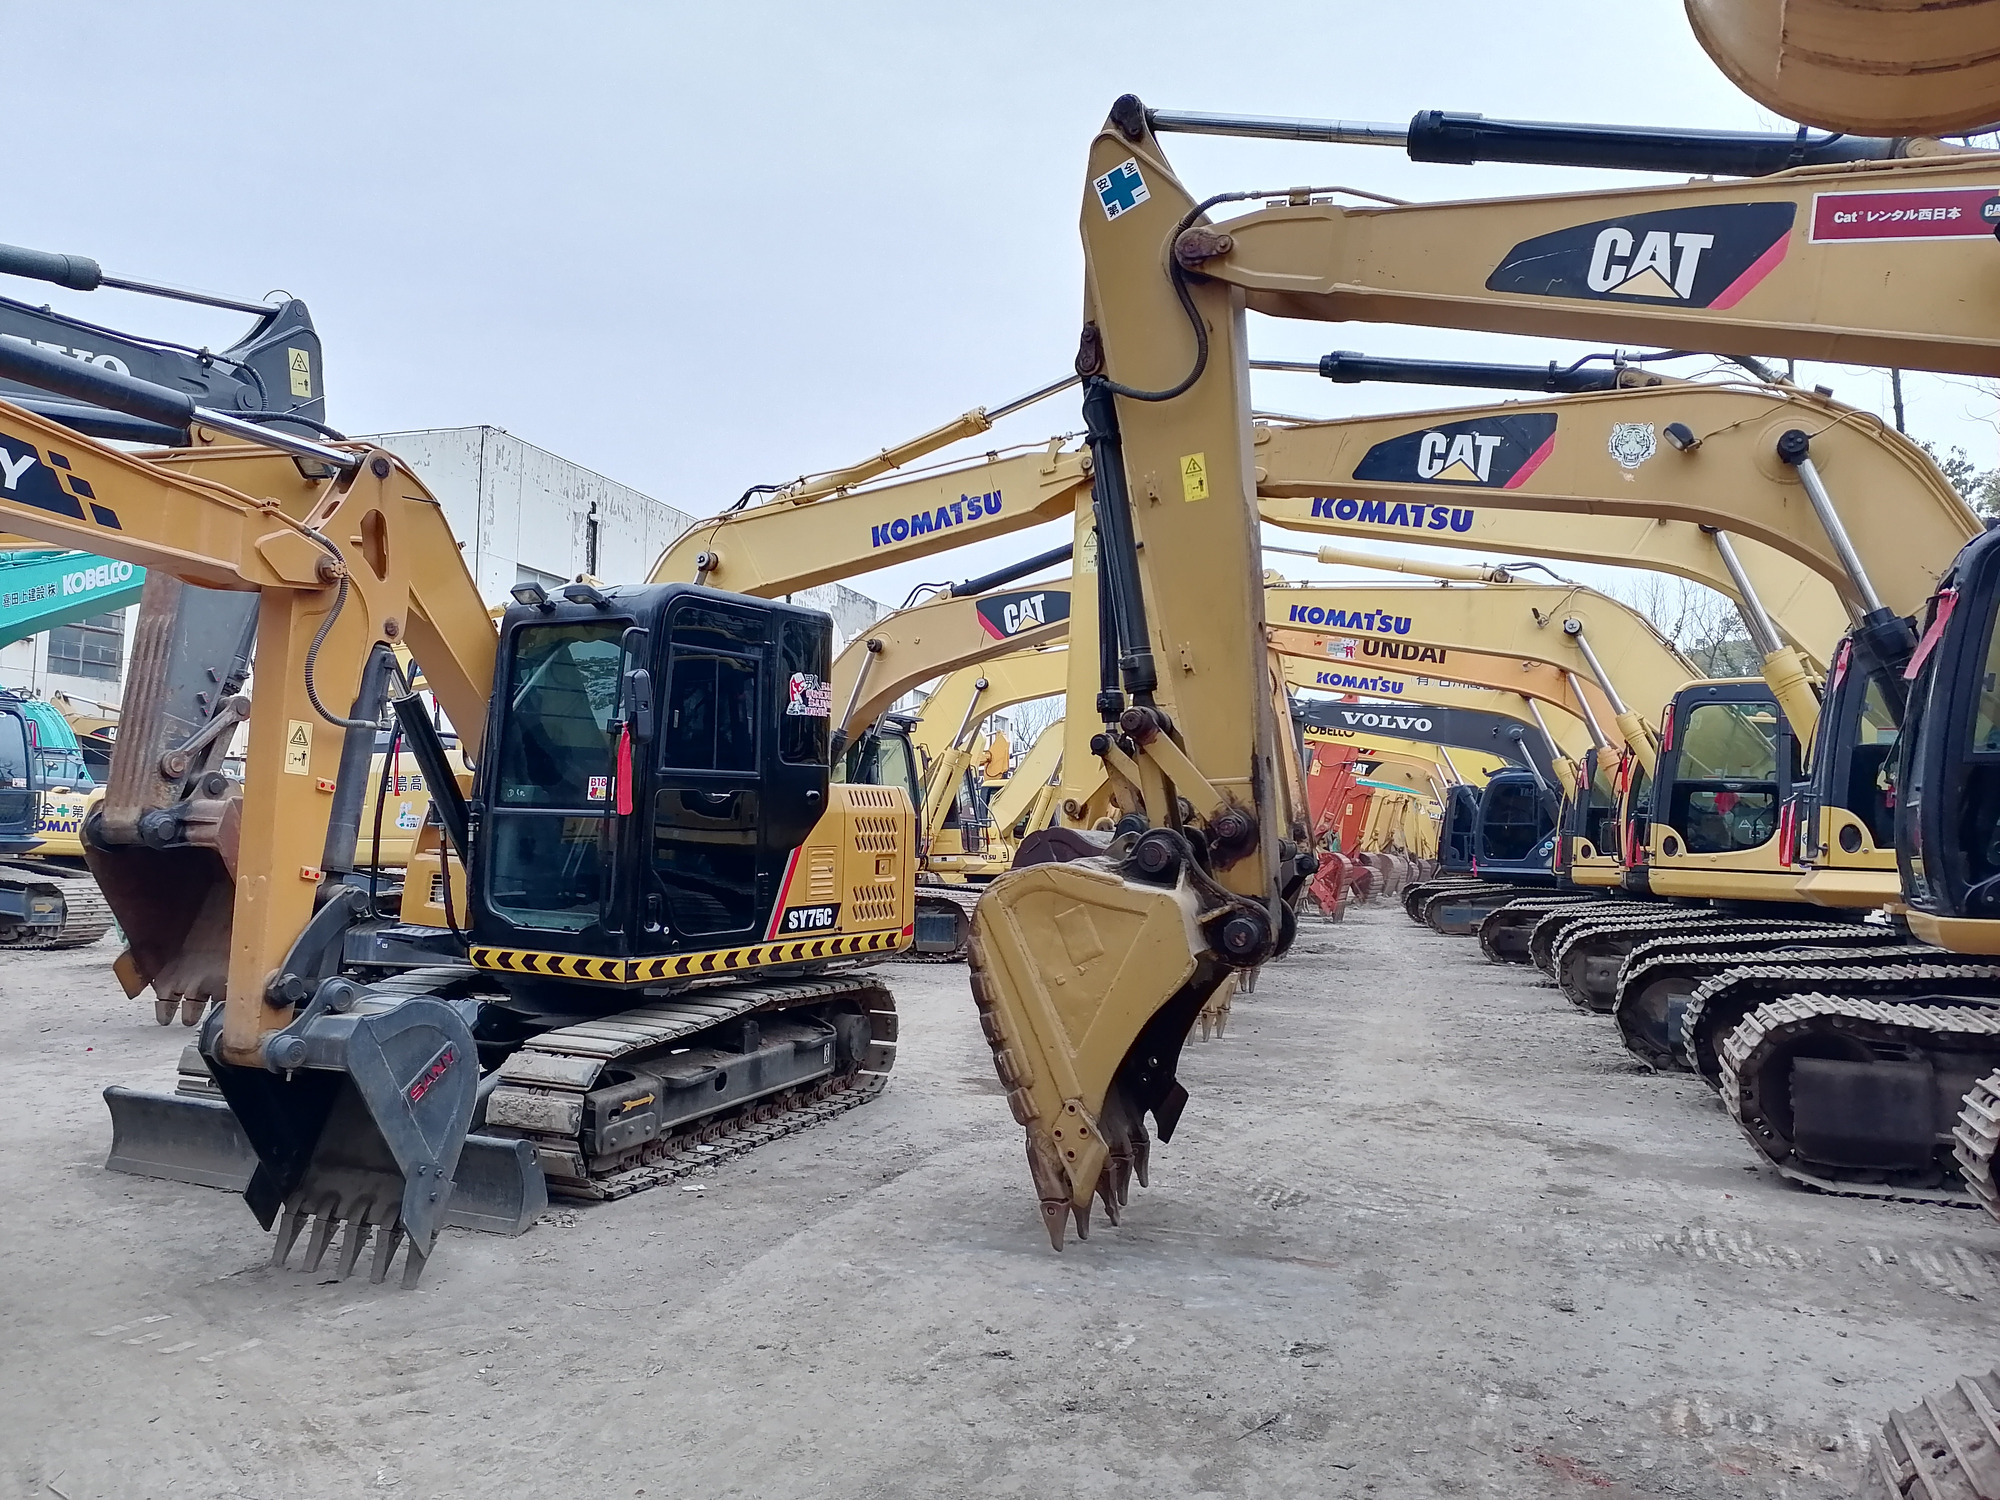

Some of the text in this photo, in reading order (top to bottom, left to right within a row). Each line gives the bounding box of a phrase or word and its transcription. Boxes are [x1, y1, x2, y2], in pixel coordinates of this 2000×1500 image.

[1866, 207, 1962, 222] レンタル西日本
[1587, 227, 1715, 299] CAT
[1417, 432, 1502, 482] CAT
[871, 489, 1003, 548] KOMATSU
[1310, 497, 1475, 533] KOMATSU
[62, 561, 134, 596] KOBELCO
[1003, 593, 1045, 634] CAT
[1289, 604, 1412, 635] KOMATSU
[1316, 672, 1404, 694] KOMATSU
[1341, 711, 1432, 732] VOLVO
[590, 777, 607, 787] B18
[788, 907, 833, 929] SY75C
